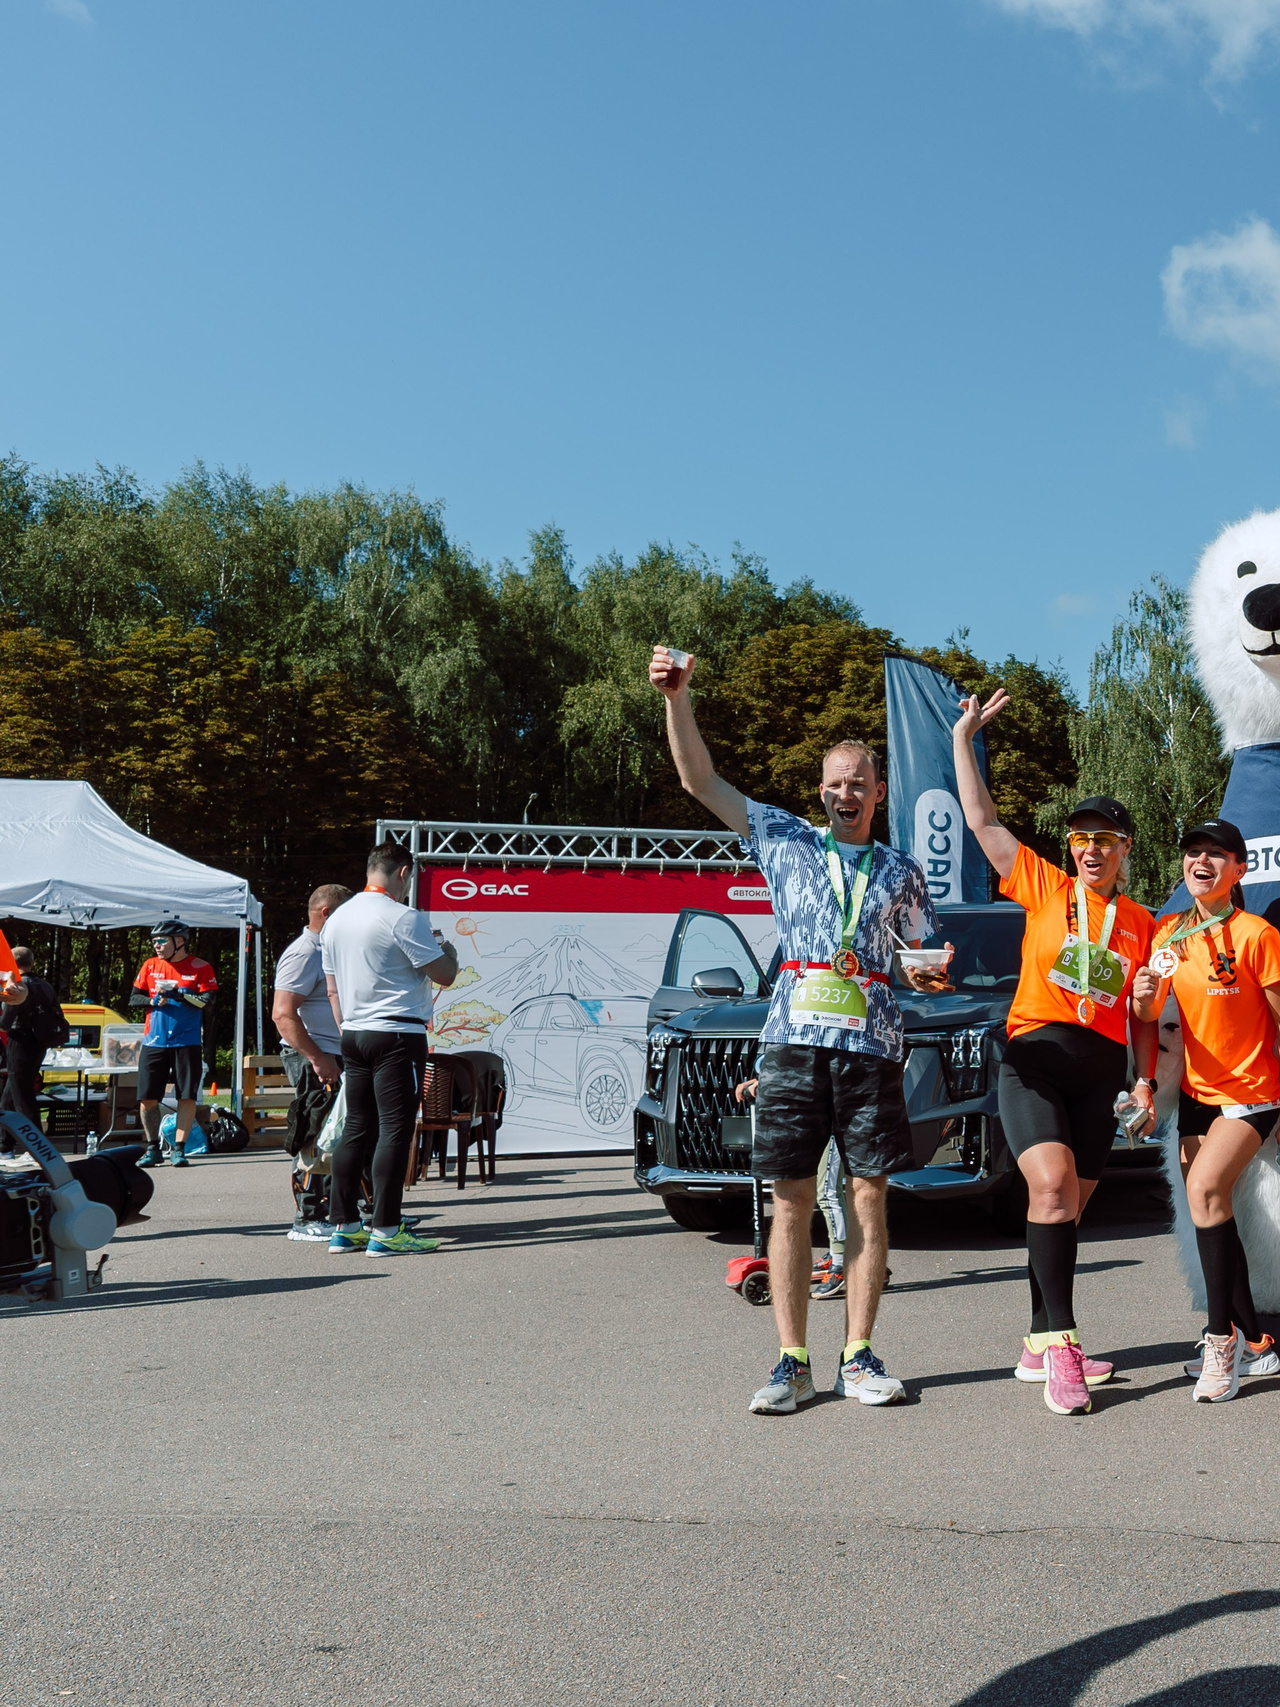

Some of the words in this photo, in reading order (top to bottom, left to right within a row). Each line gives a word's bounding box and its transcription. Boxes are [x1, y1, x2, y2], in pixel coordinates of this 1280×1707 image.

[480, 884, 529, 896] GAC
[733, 889, 771, 897] АВТОКЛ
[810, 986, 851, 1005] 5237
[1206, 987, 1240, 996] LIPETSK
[18, 1124, 57, 1163] RONIN
